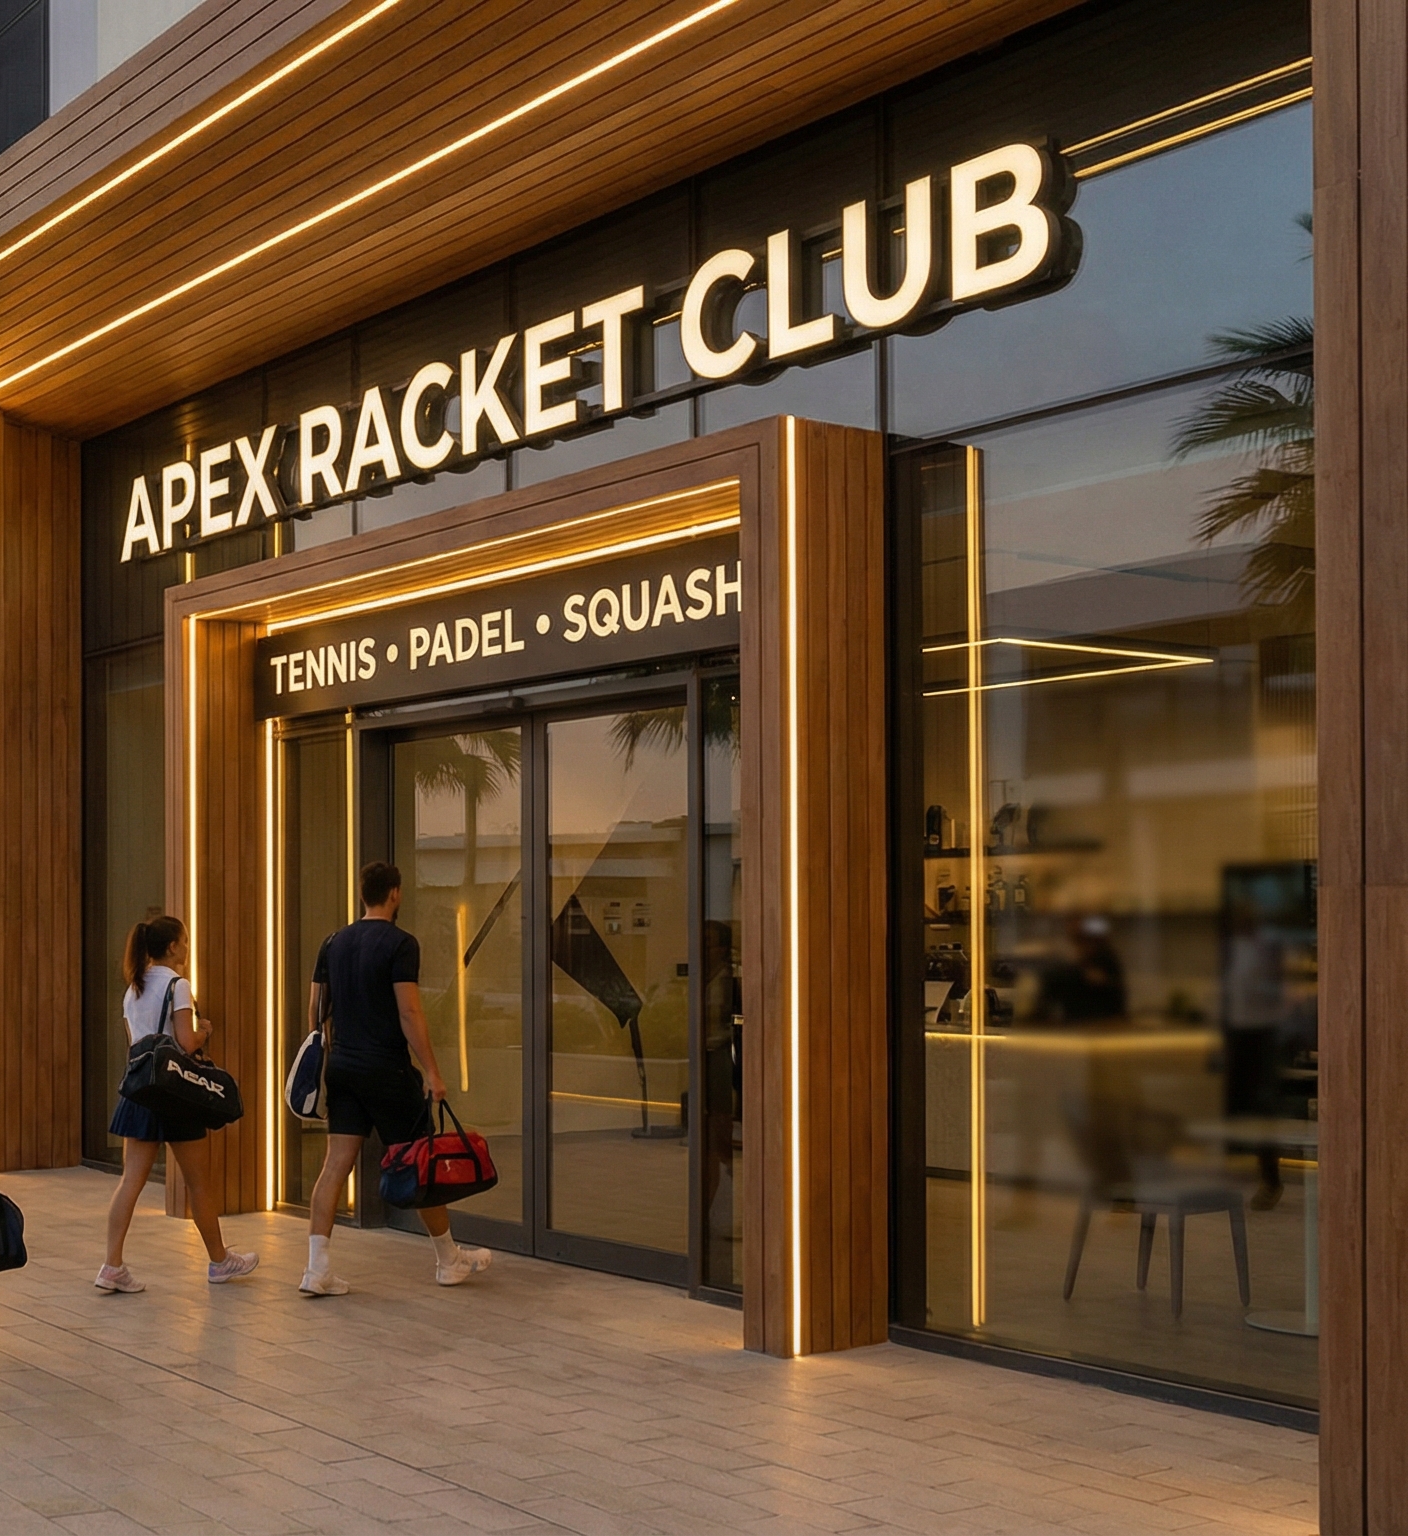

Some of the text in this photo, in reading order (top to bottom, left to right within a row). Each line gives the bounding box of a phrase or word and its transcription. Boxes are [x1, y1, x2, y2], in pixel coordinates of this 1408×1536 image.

[120, 143, 1050, 563] APEX RACKET CLUB
[270, 560, 742, 696] TENNIS PADEL SQUASH
